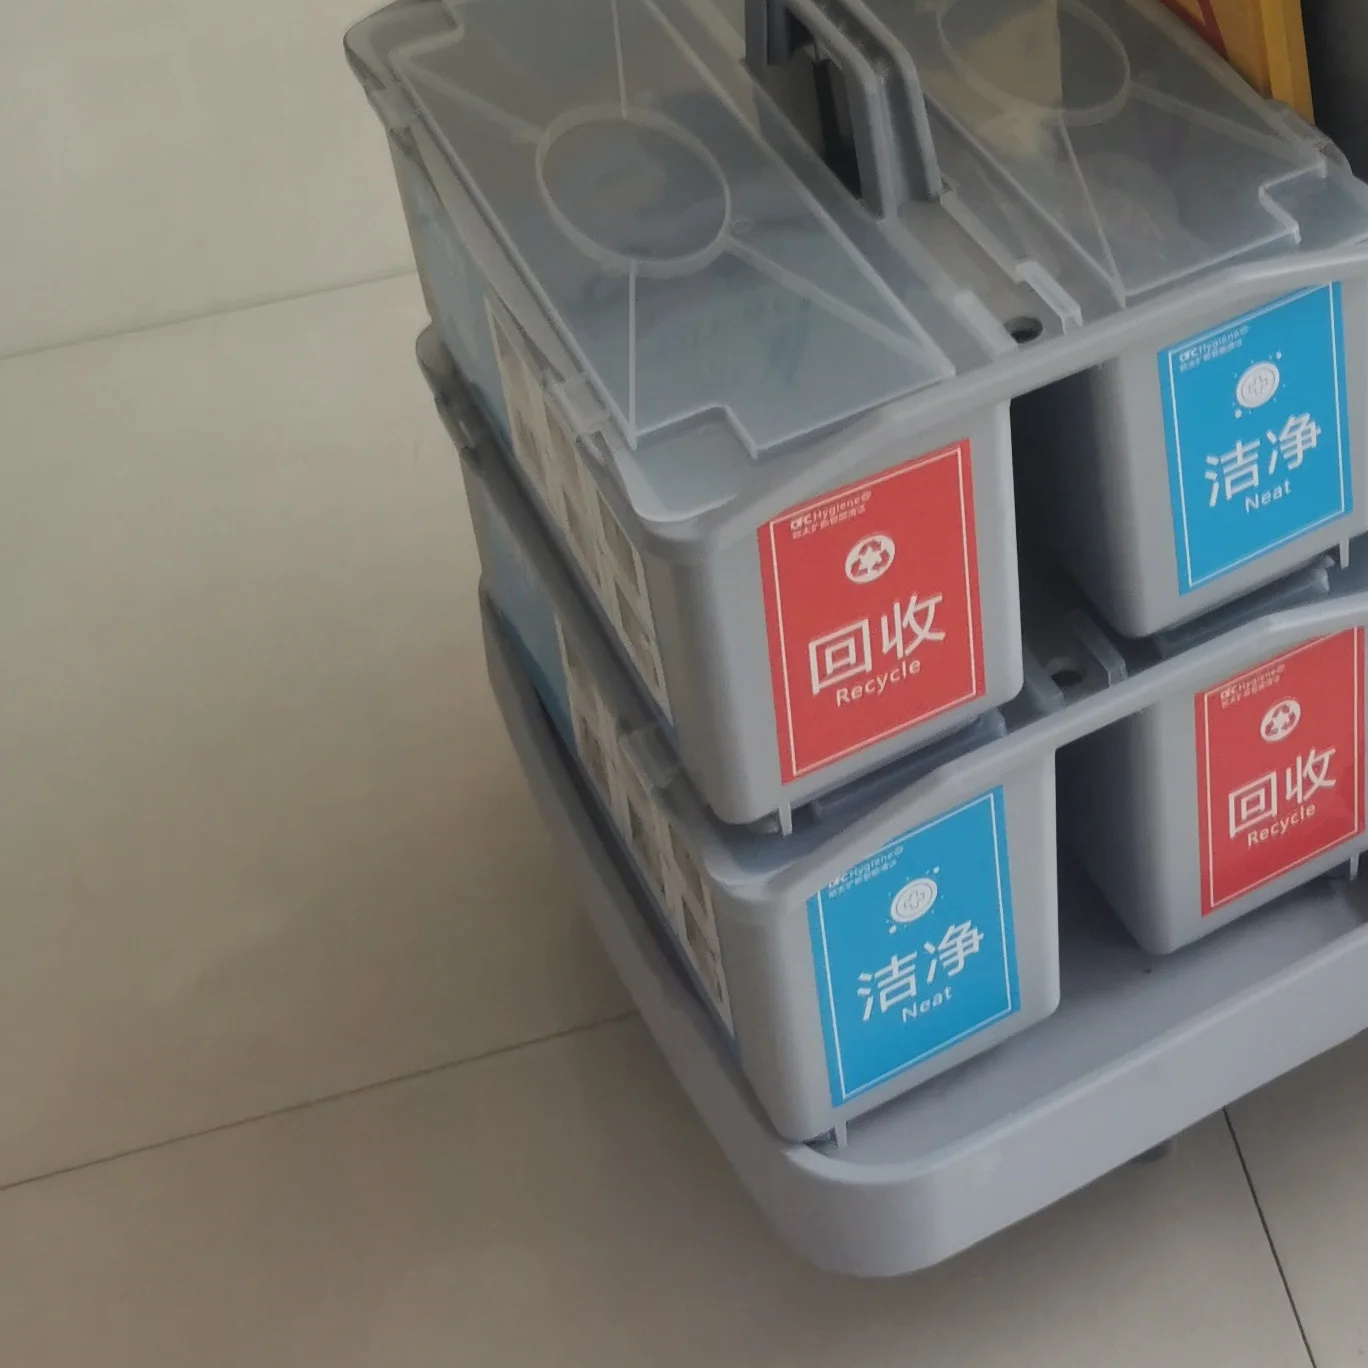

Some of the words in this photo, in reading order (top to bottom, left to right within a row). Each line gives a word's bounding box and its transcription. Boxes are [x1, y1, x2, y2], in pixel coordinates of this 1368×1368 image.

[1204, 411, 1322, 508] 洁净
[1244, 479, 1291, 514] Neat
[808, 592, 946, 696] 回收
[836, 658, 921, 707] Recycle
[1228, 747, 1337, 840] 回收
[1247, 803, 1316, 847] Recycle
[856, 919, 985, 1022] 洁净
[901, 986, 952, 1023] Neat
